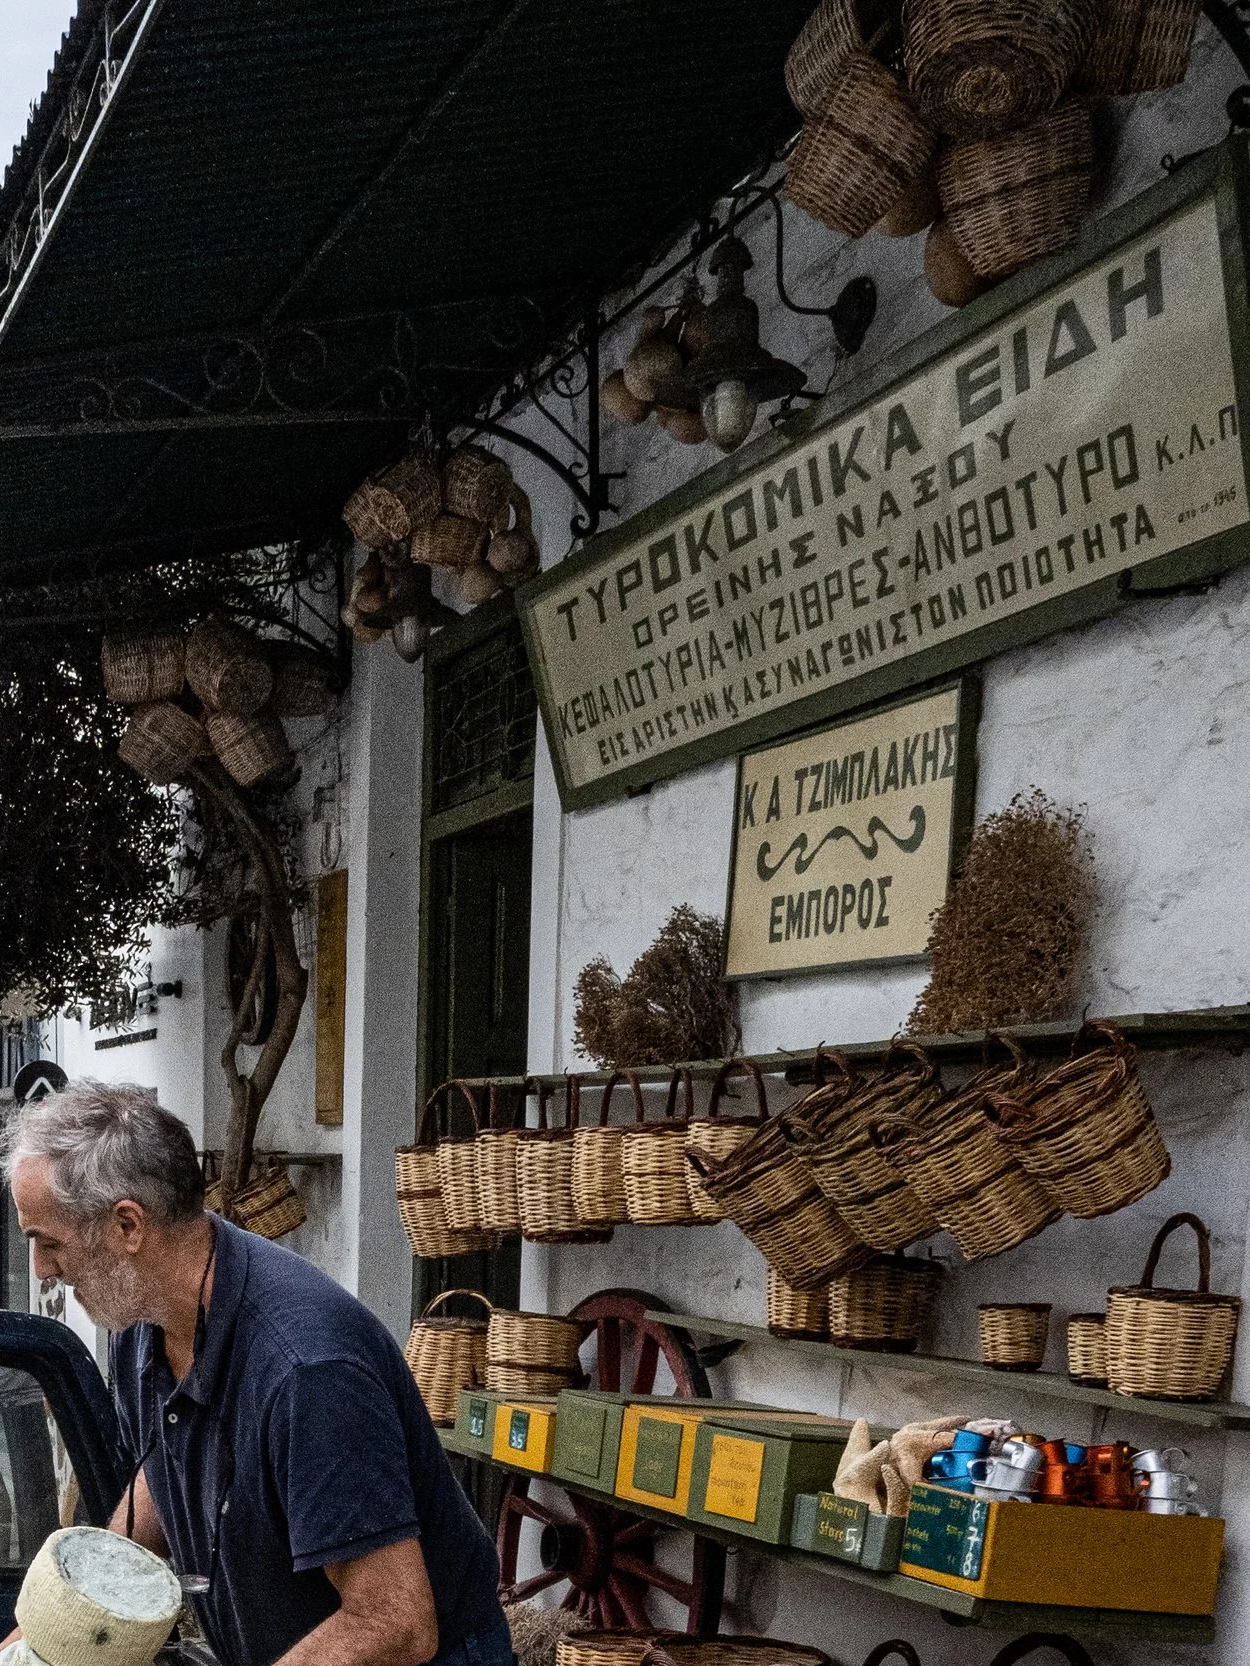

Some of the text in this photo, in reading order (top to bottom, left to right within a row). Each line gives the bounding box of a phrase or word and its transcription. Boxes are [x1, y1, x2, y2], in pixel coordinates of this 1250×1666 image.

[557, 246, 1164, 641] ΤΥΡΟΚΟΜΙΚΑ ΕΙΔΗ
[632, 418, 1016, 649] ΟΡΕΙΝΗΣ ΝΑΞΟΥ
[975, 503, 1156, 610] ΠΟΙΟΤΗΤΑ
[794, 725, 958, 816] ΤΖΙΜΠΛΑΚΗΣ
[769, 875, 892, 943] ΕΜΠΟΡΟΣ
[820, 1495, 859, 1520] Natural
